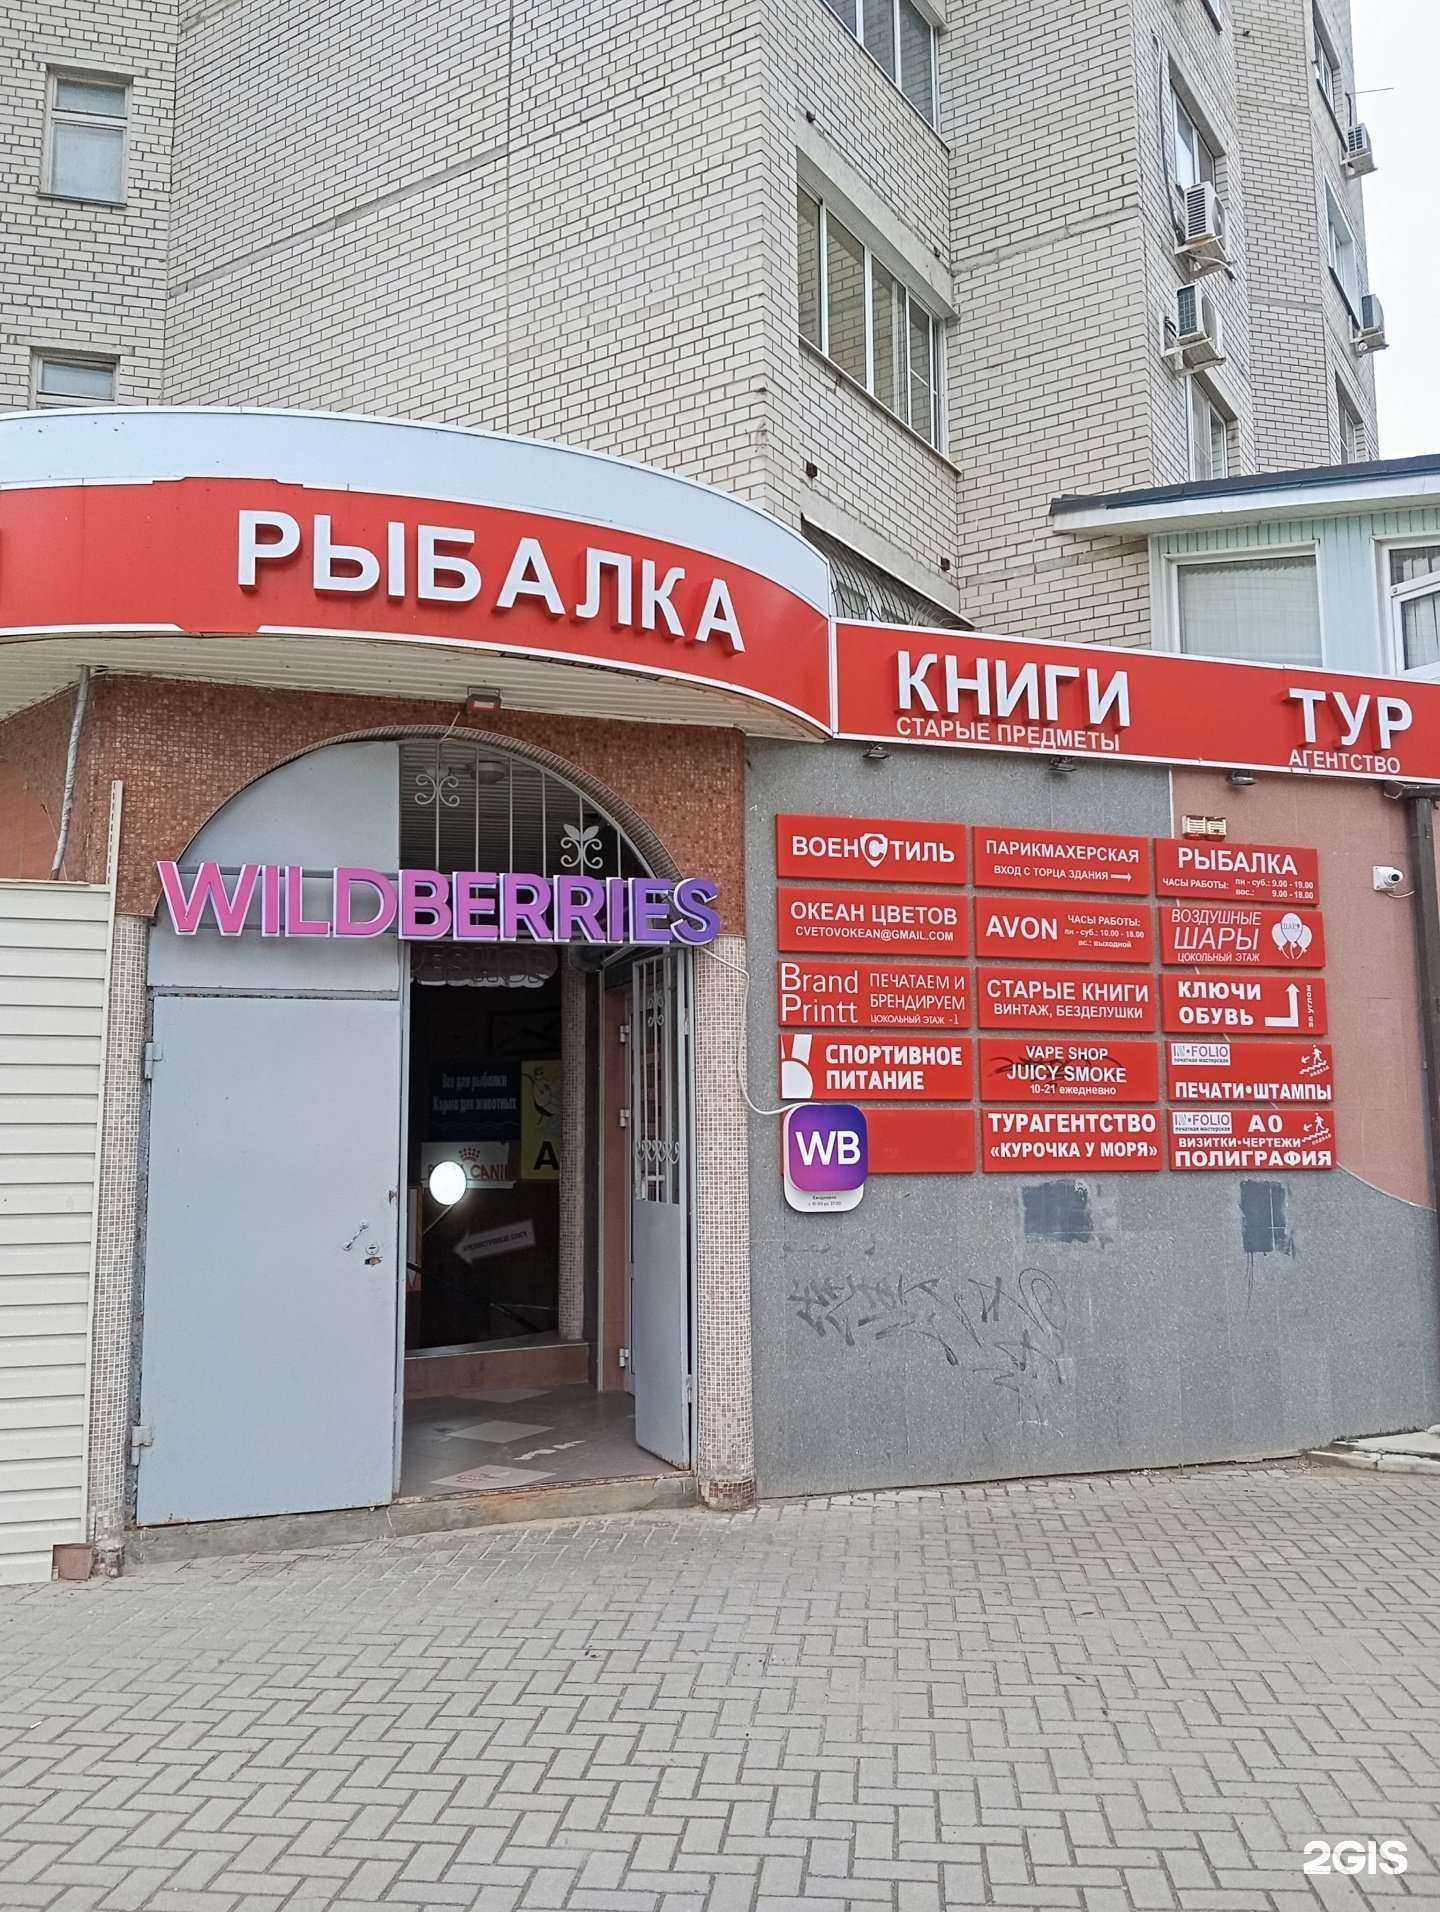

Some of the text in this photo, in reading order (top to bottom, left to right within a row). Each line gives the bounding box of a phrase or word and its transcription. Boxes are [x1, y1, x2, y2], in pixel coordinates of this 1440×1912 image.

[236, 509, 746, 652] РЫБАЛКА
[896, 650, 1131, 728] КНИГИ
[1282, 687, 1413, 749] ТУР
[896, 716, 1121, 752] СТАРЫЕ ПРЕДМЕТЫ
[1289, 749, 1401, 774] АГЕНТСТВО
[792, 833, 955, 868] ВОЕНСТИЛЬ
[986, 840, 1140, 863] ПАРИКМАХЕРСКАЯ
[1178, 847, 1298, 875] РЫБАЛКА
[994, 866, 1109, 880] ВХОД С ТОРЦА ЗДАНИЯ
[1272, 879, 1287, 887] 9.00
[1163, 878, 1229, 889] ЧАСЫ РАБОТЫ:
[156, 860, 721, 945] WILDBERRIES
[1272, 890, 1287, 898] 9.00
[791, 902, 957, 925] ОКЕАН ЦВЕТОВ
[1068, 915, 1140, 926] ЧАСЫ РАБОТЫ:
[1171, 909, 1262, 926] ВОЗДУШНЫЕ
[796, 926, 954, 942] CVETOVOKEAN@GMAIL.COM
[985, 915, 1058, 940] AVON
[1174, 927, 1259, 950] ШАРЫ
[1178, 952, 1260, 962] ЦОКОЛЬНЫЙ ЭТАЖ
[781, 962, 859, 993] Brand
[870, 973, 965, 990] ПЕЧАТАЕМ И
[987, 979, 1149, 1003] СТАРЫЕ КНИГИ
[1178, 981, 1261, 1001] КЛЮЧИ
[781, 993, 858, 1023] Printt
[870, 994, 965, 1011] БРЕНДИРУЕМ
[994, 1004, 1143, 1019] ВИНТАЖ, БЕЗДЕЛУШКИ
[870, 1014, 920, 1024] ЦОКОЛЬНЫЙ
[923, 1016, 944, 1024] ЭТАЖ
[1179, 1006, 1254, 1026] ОБУВЬ
[825, 1045, 963, 1066] СПОРТИВНОЕ
[1026, 1046, 1109, 1060] VAPE SHOP
[826, 1070, 924, 1090] ПИТАНИЕ
[1007, 1065, 1127, 1083] JUICY SMOKE
[1030, 1084, 1116, 1096] 10-21 ежедневно
[988, 1113, 1156, 1133] ТУРАГЕНТСТВО
[795, 1131, 861, 1166] WB
[991, 1142, 1158, 1158] «КУРОЧКА У МОРЯ»
[1175, 1151, 1332, 1167] ПОЛИГРАФИЯ
